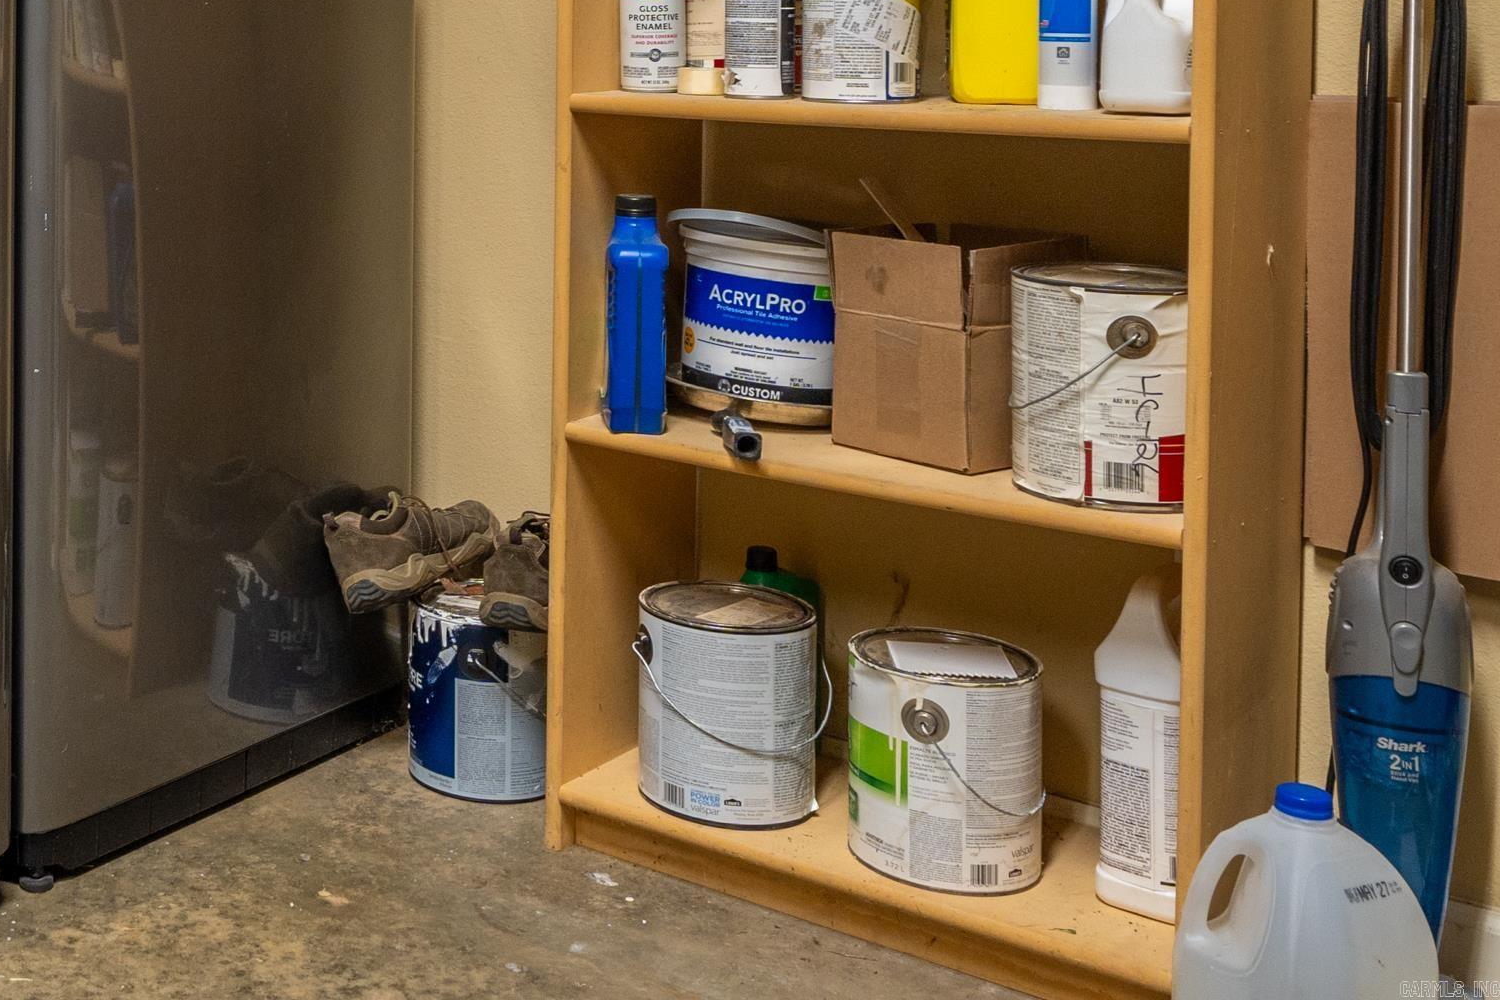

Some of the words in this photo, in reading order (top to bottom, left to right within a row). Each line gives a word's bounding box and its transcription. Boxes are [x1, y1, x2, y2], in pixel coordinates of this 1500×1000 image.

[628, 13, 679, 22] PROTECTIVE
[636, 22, 673, 31] ENAMEL
[716, 303, 754, 316] Professional
[755, 310, 767, 318] Tile
[768, 312, 798, 322] Adhesive
[731, 383, 781, 400] CUSTOM
[1376, 736, 1428, 753] Shark
[690, 791, 721, 802] POWER
[690, 804, 720, 816] valspar
[698, 799, 721, 808] COLOR
[1011, 843, 1035, 858] valspar
[1356, 883, 1377, 902] MAY
[1375, 880, 1390, 898] 27
